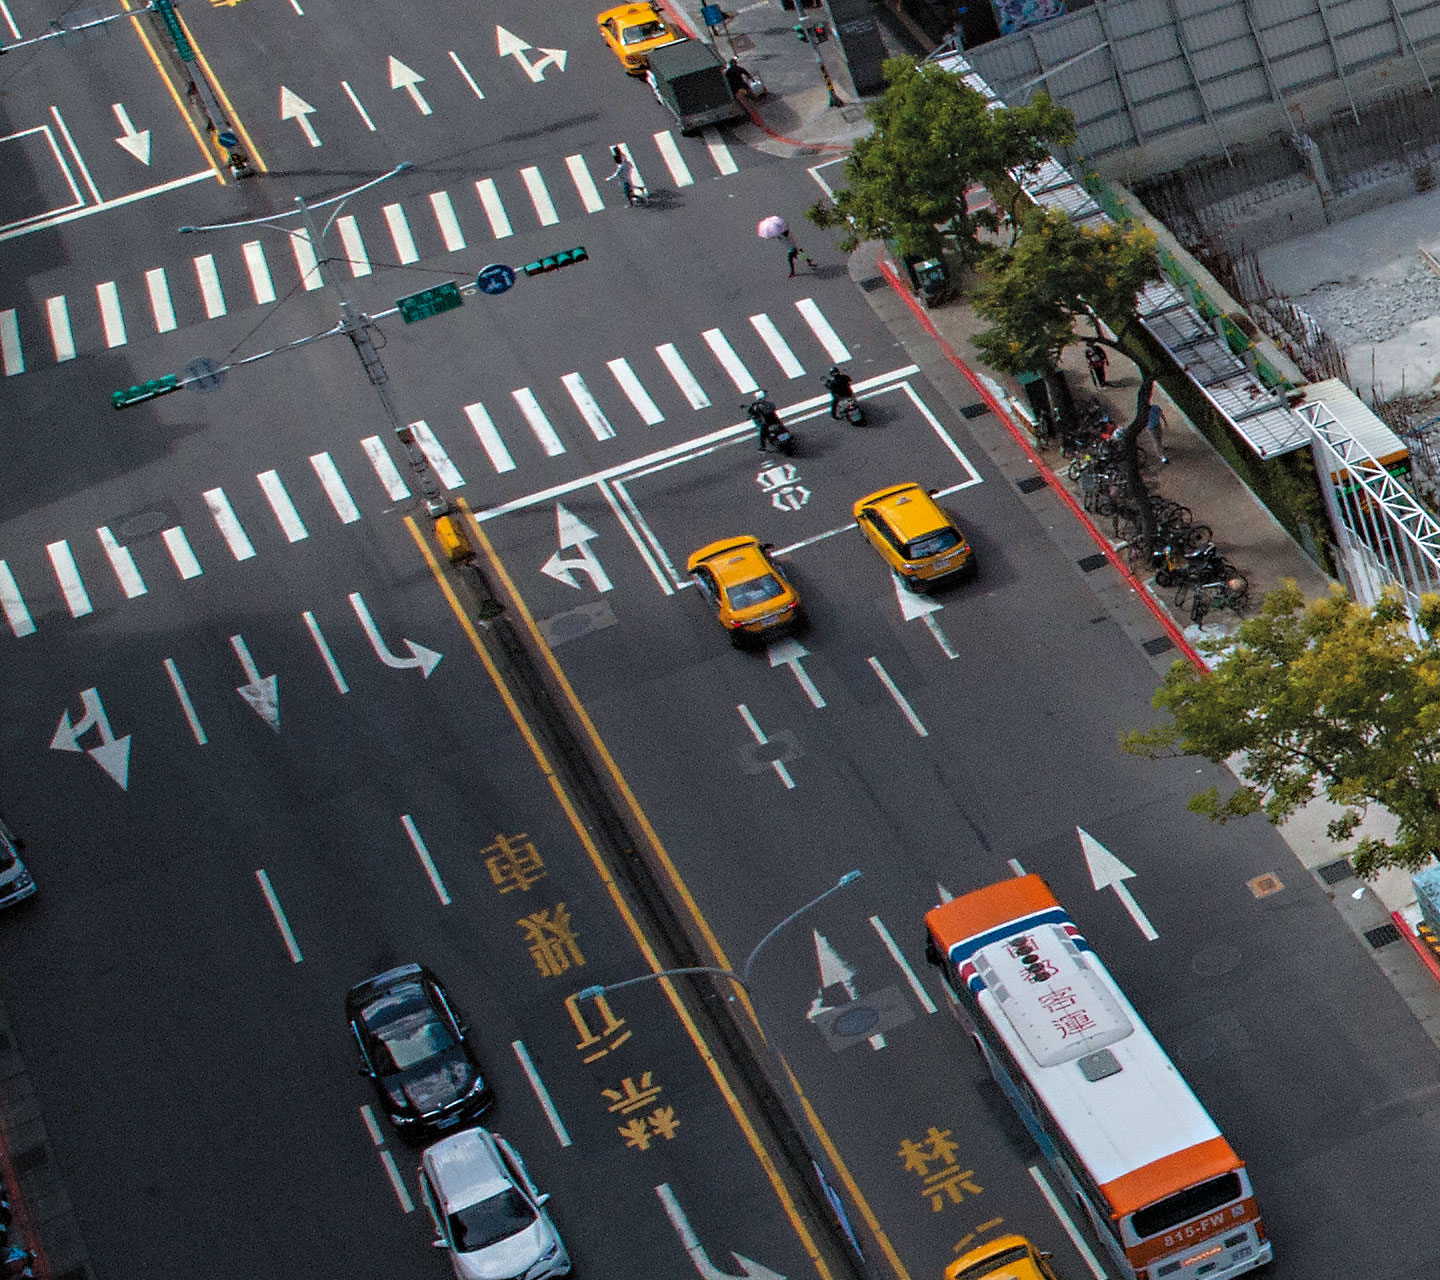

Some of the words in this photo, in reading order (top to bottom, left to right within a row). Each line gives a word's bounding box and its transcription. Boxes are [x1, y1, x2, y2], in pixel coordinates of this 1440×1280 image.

[481, 833, 680, 1150] 禁行機車
[1163, 1212, 1225, 1248] 815-FW
